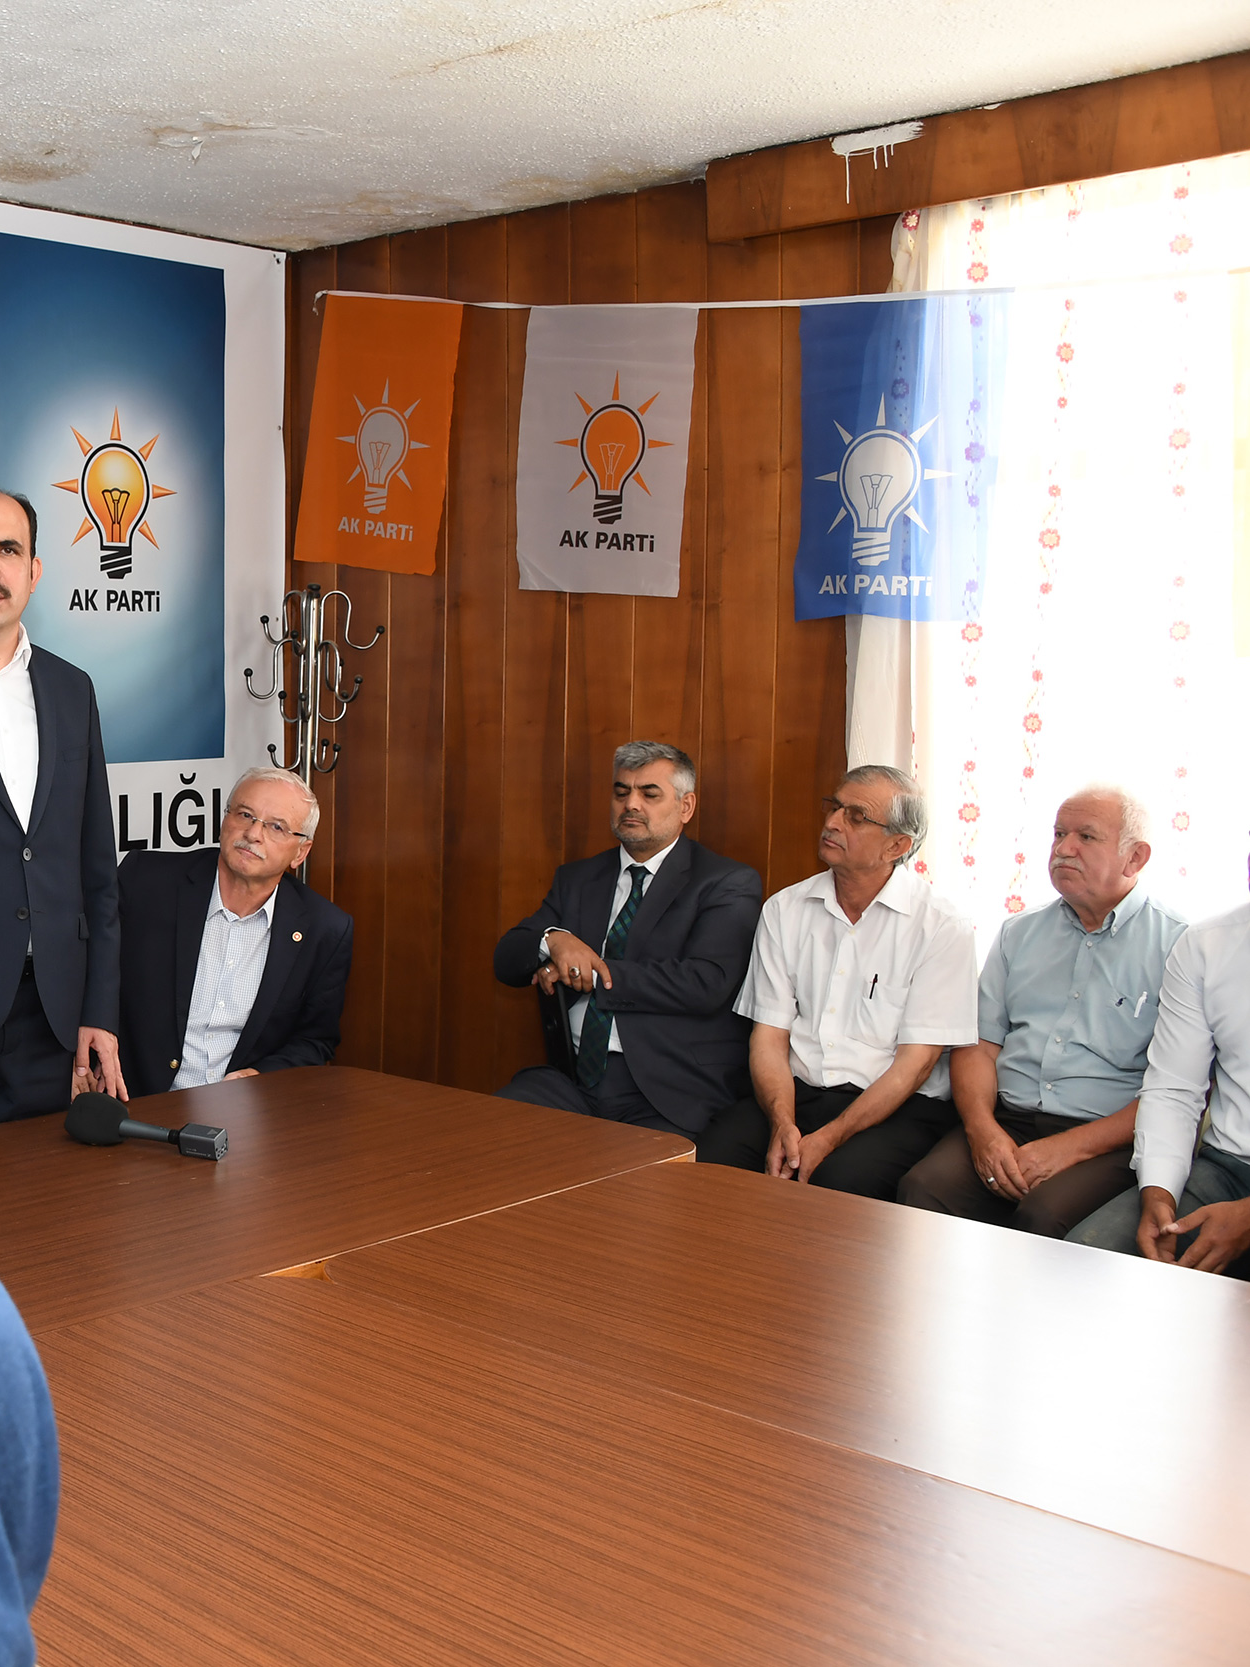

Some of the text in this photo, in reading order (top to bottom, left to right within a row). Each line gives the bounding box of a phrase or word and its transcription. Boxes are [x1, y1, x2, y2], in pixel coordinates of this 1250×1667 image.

[337, 517, 361, 534] AK
[559, 529, 589, 548] AK
[818, 574, 848, 595] AK
[68, 588, 99, 611] AK
